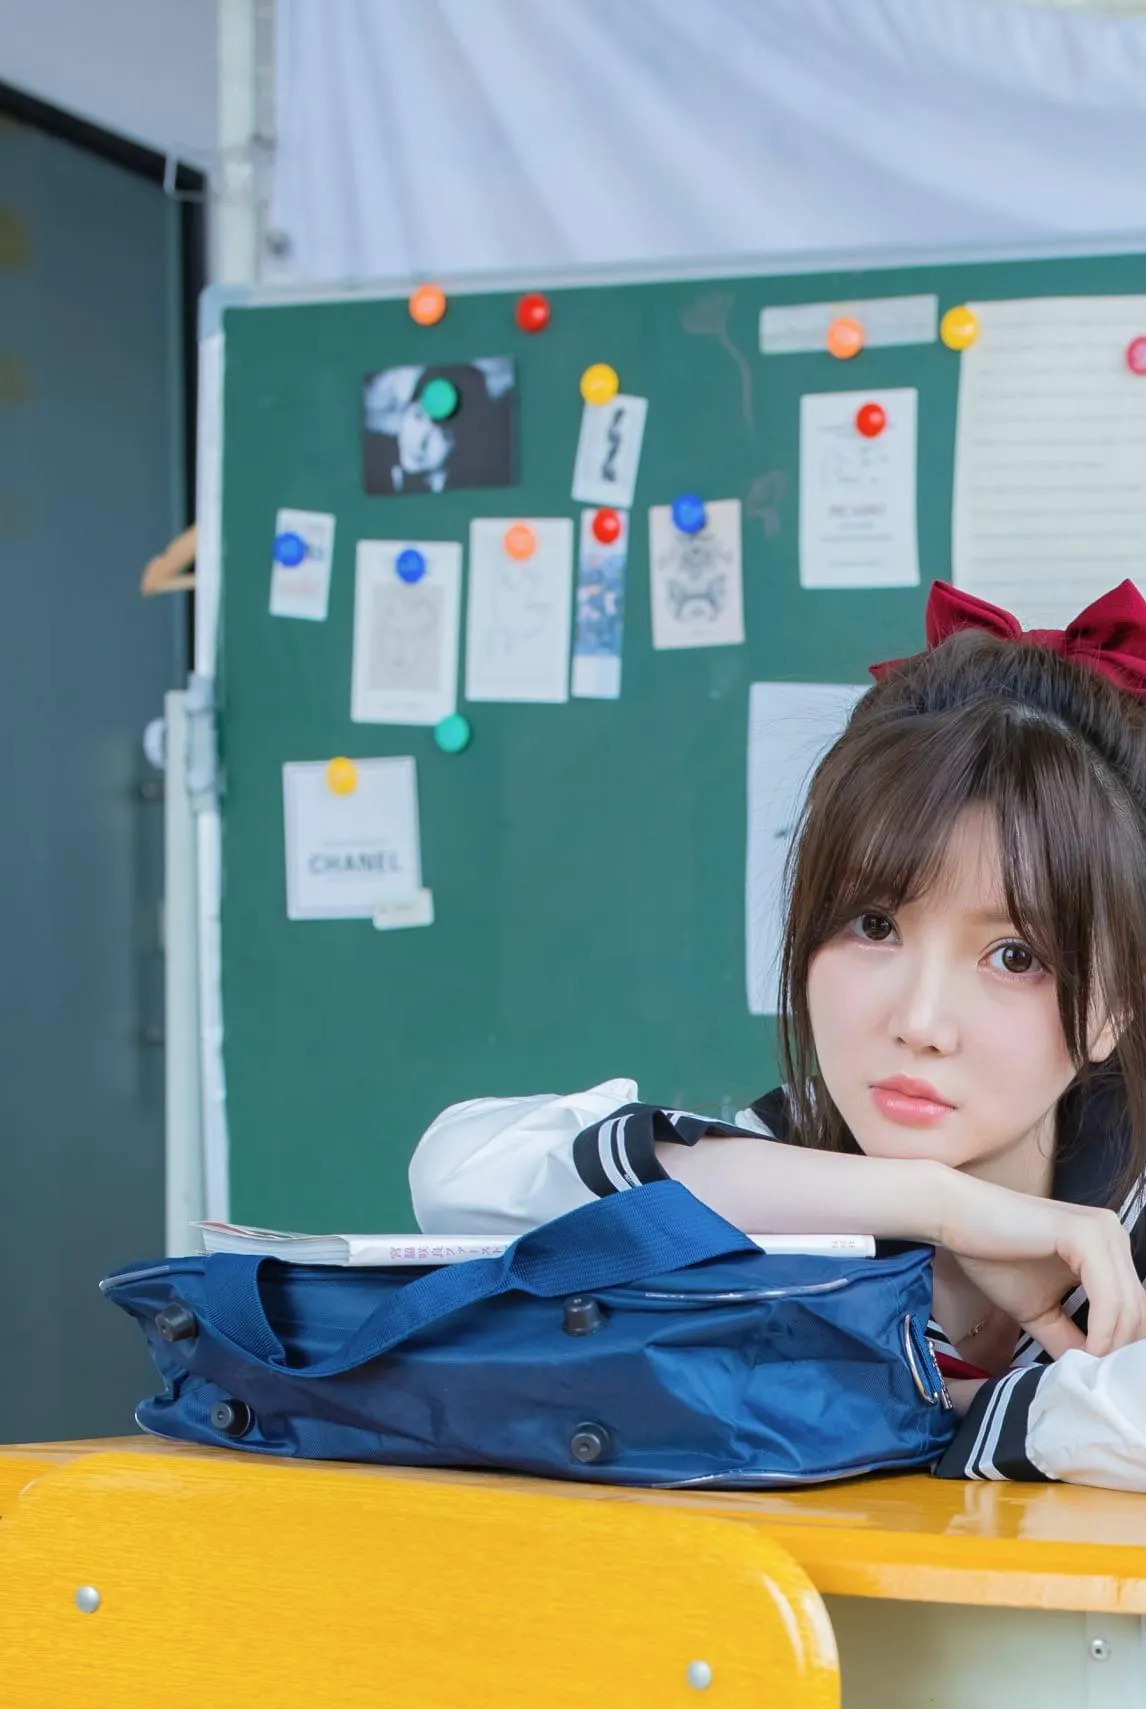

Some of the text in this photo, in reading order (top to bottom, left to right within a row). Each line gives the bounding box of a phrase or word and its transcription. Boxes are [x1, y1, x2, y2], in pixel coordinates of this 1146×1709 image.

[308, 850, 402, 877] CHANEL
[389, 1245, 507, 1260] 宮脇咲良ファースト
